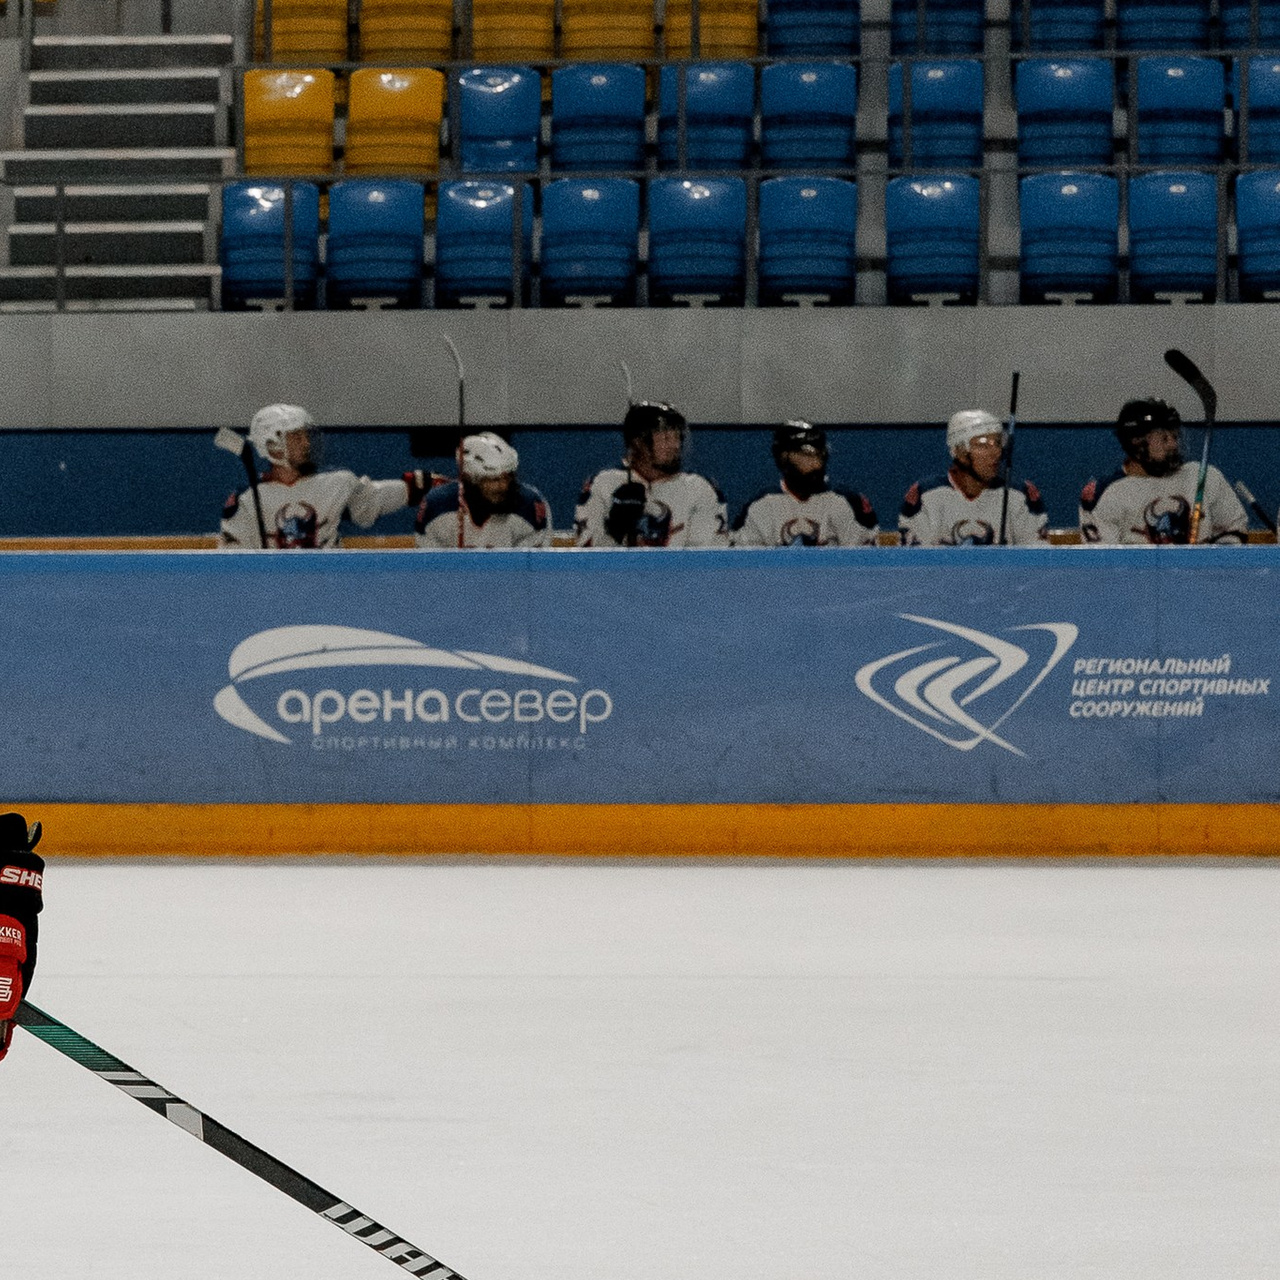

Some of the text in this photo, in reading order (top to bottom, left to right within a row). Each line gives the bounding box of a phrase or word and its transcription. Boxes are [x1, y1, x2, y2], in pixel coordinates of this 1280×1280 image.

[1073, 653, 1232, 675] РЕГИОНАЛЬНЫЙ
[1072, 678, 1270, 697] ЦЕНТР СПОРТИВНЫХ
[1069, 696, 1204, 718] СООРУЖЕНИЙ
[0, 867, 42, 890] SHE
